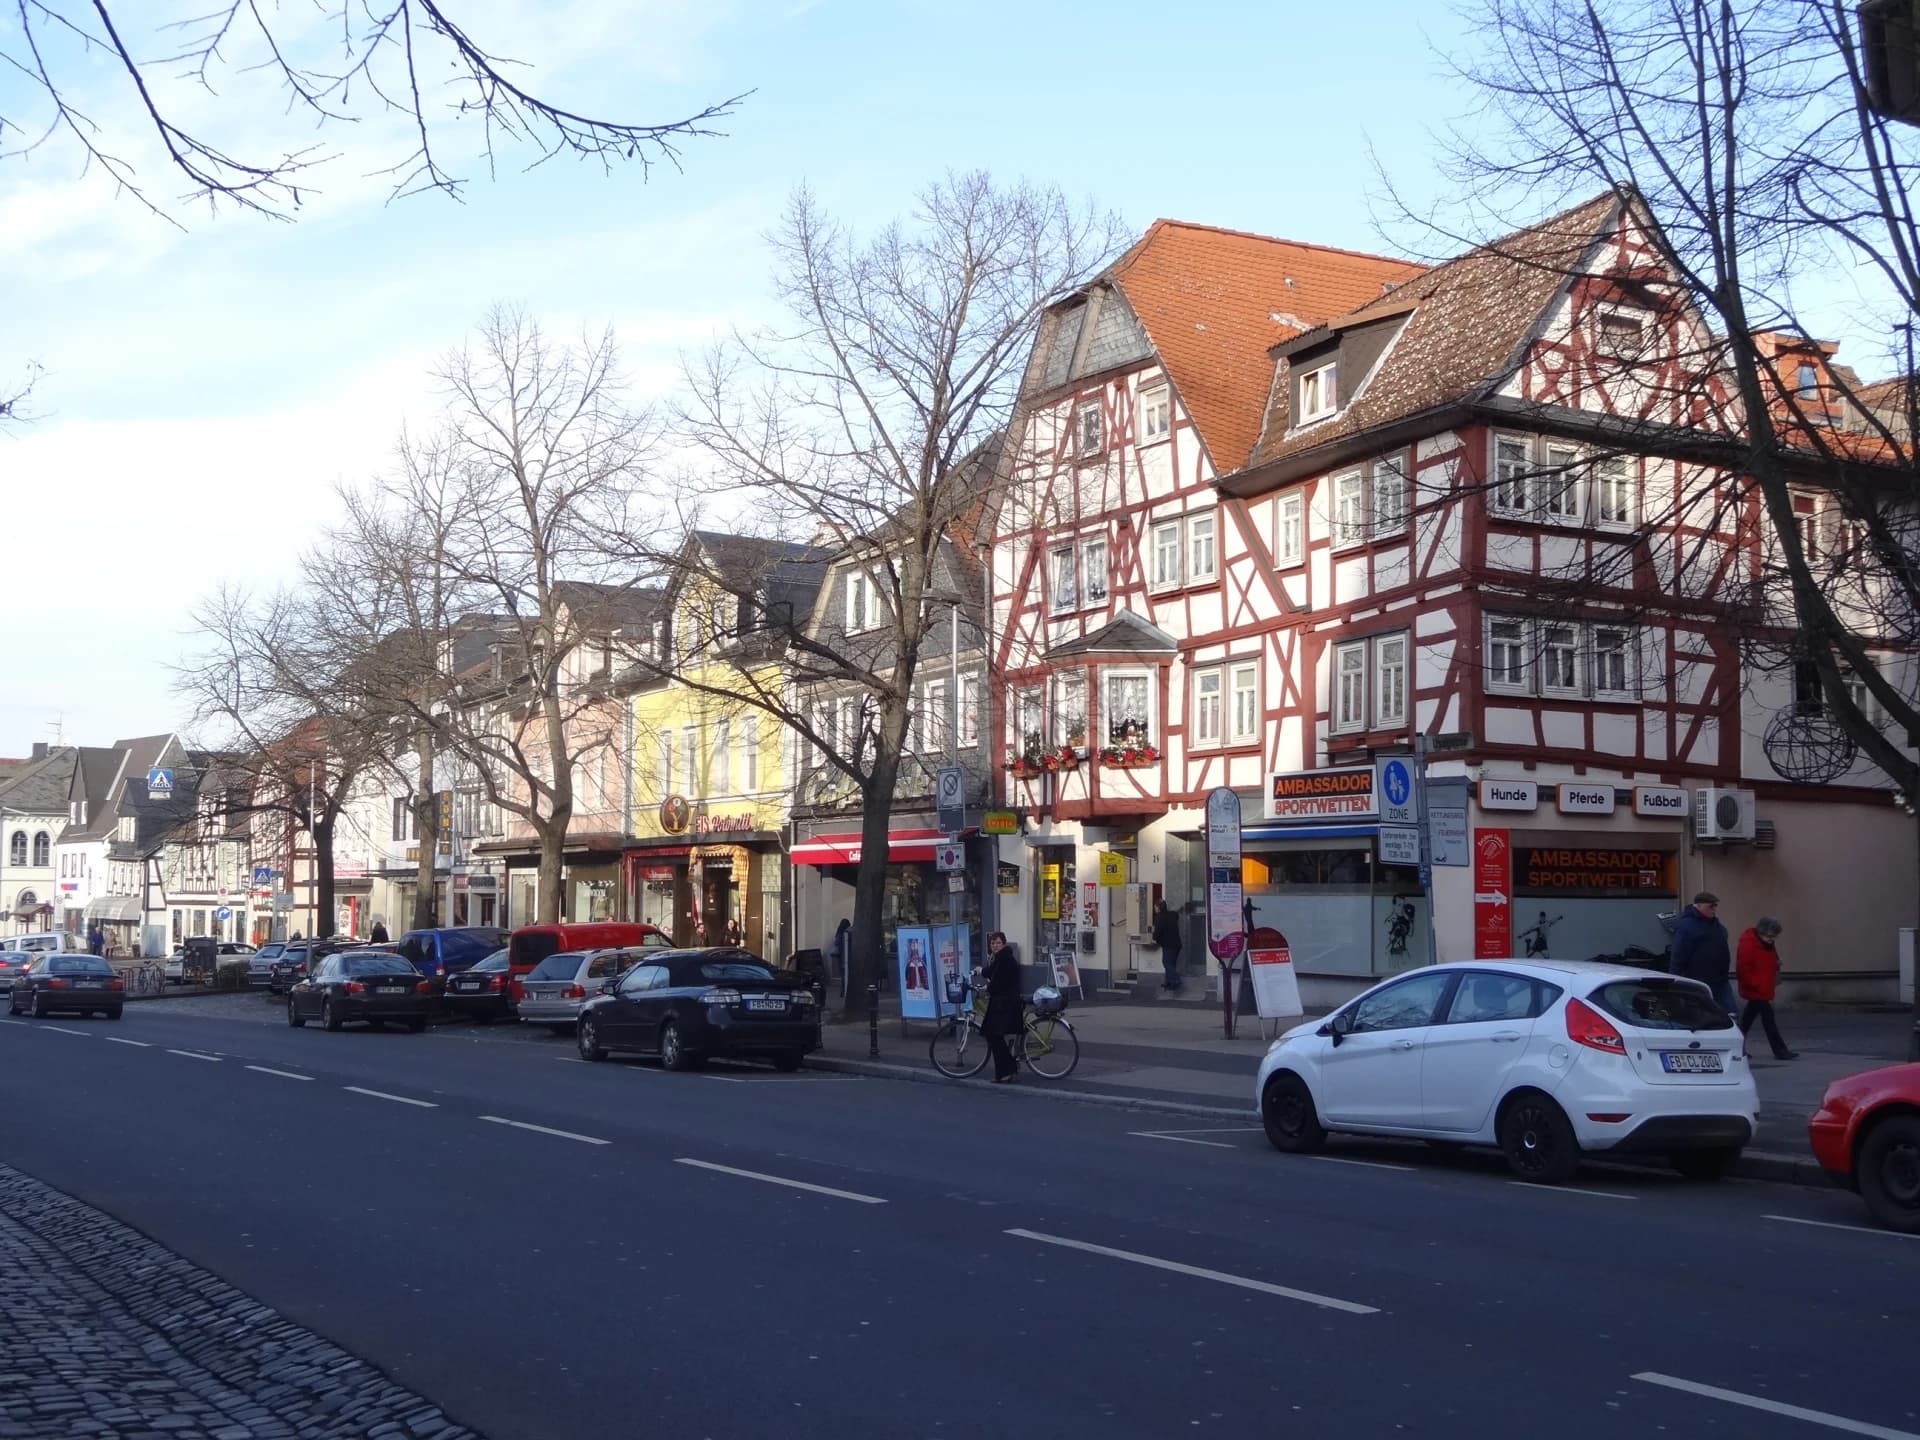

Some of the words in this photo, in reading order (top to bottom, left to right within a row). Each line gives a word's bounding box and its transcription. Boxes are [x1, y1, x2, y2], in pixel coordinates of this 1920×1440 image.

[1275, 774, 1371, 795] AMBASSADOR
[1491, 788, 1528, 801] Hunde
[1569, 792, 1605, 805] Pferde
[1274, 796, 1371, 816] SPORTWETTEN
[1643, 795, 1682, 808] Fußball
[1389, 808, 1409, 820] ZONE
[696, 816, 709, 833] EIS
[987, 817, 1014, 828] LOTTO
[1528, 850, 1662, 868] AMBASSADOR
[1528, 871, 1662, 887] SPORTWETTEN
[1669, 1056, 1682, 1068] FB
